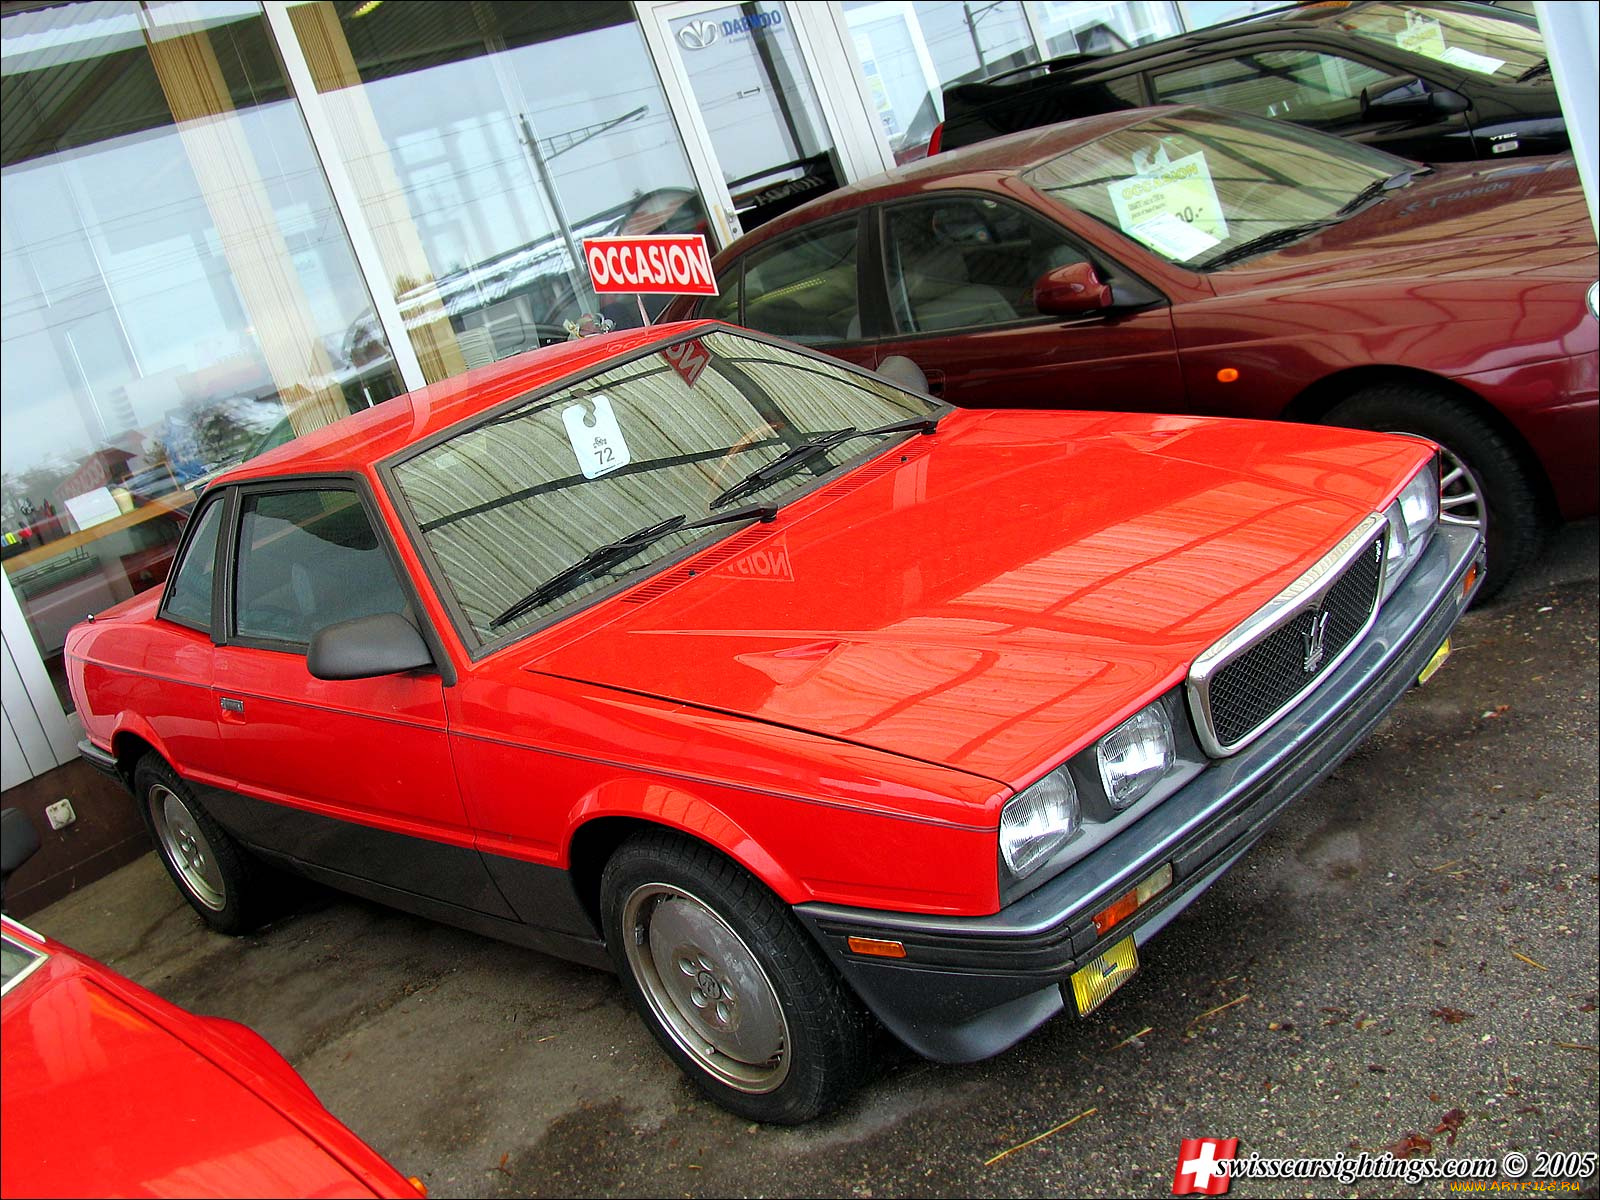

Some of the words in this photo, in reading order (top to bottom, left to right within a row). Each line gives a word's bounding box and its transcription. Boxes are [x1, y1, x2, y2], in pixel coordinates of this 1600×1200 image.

[722, 10, 782, 36] DAEWOO
[588, 244, 713, 286] OCCASION
[594, 447, 615, 465] 72
